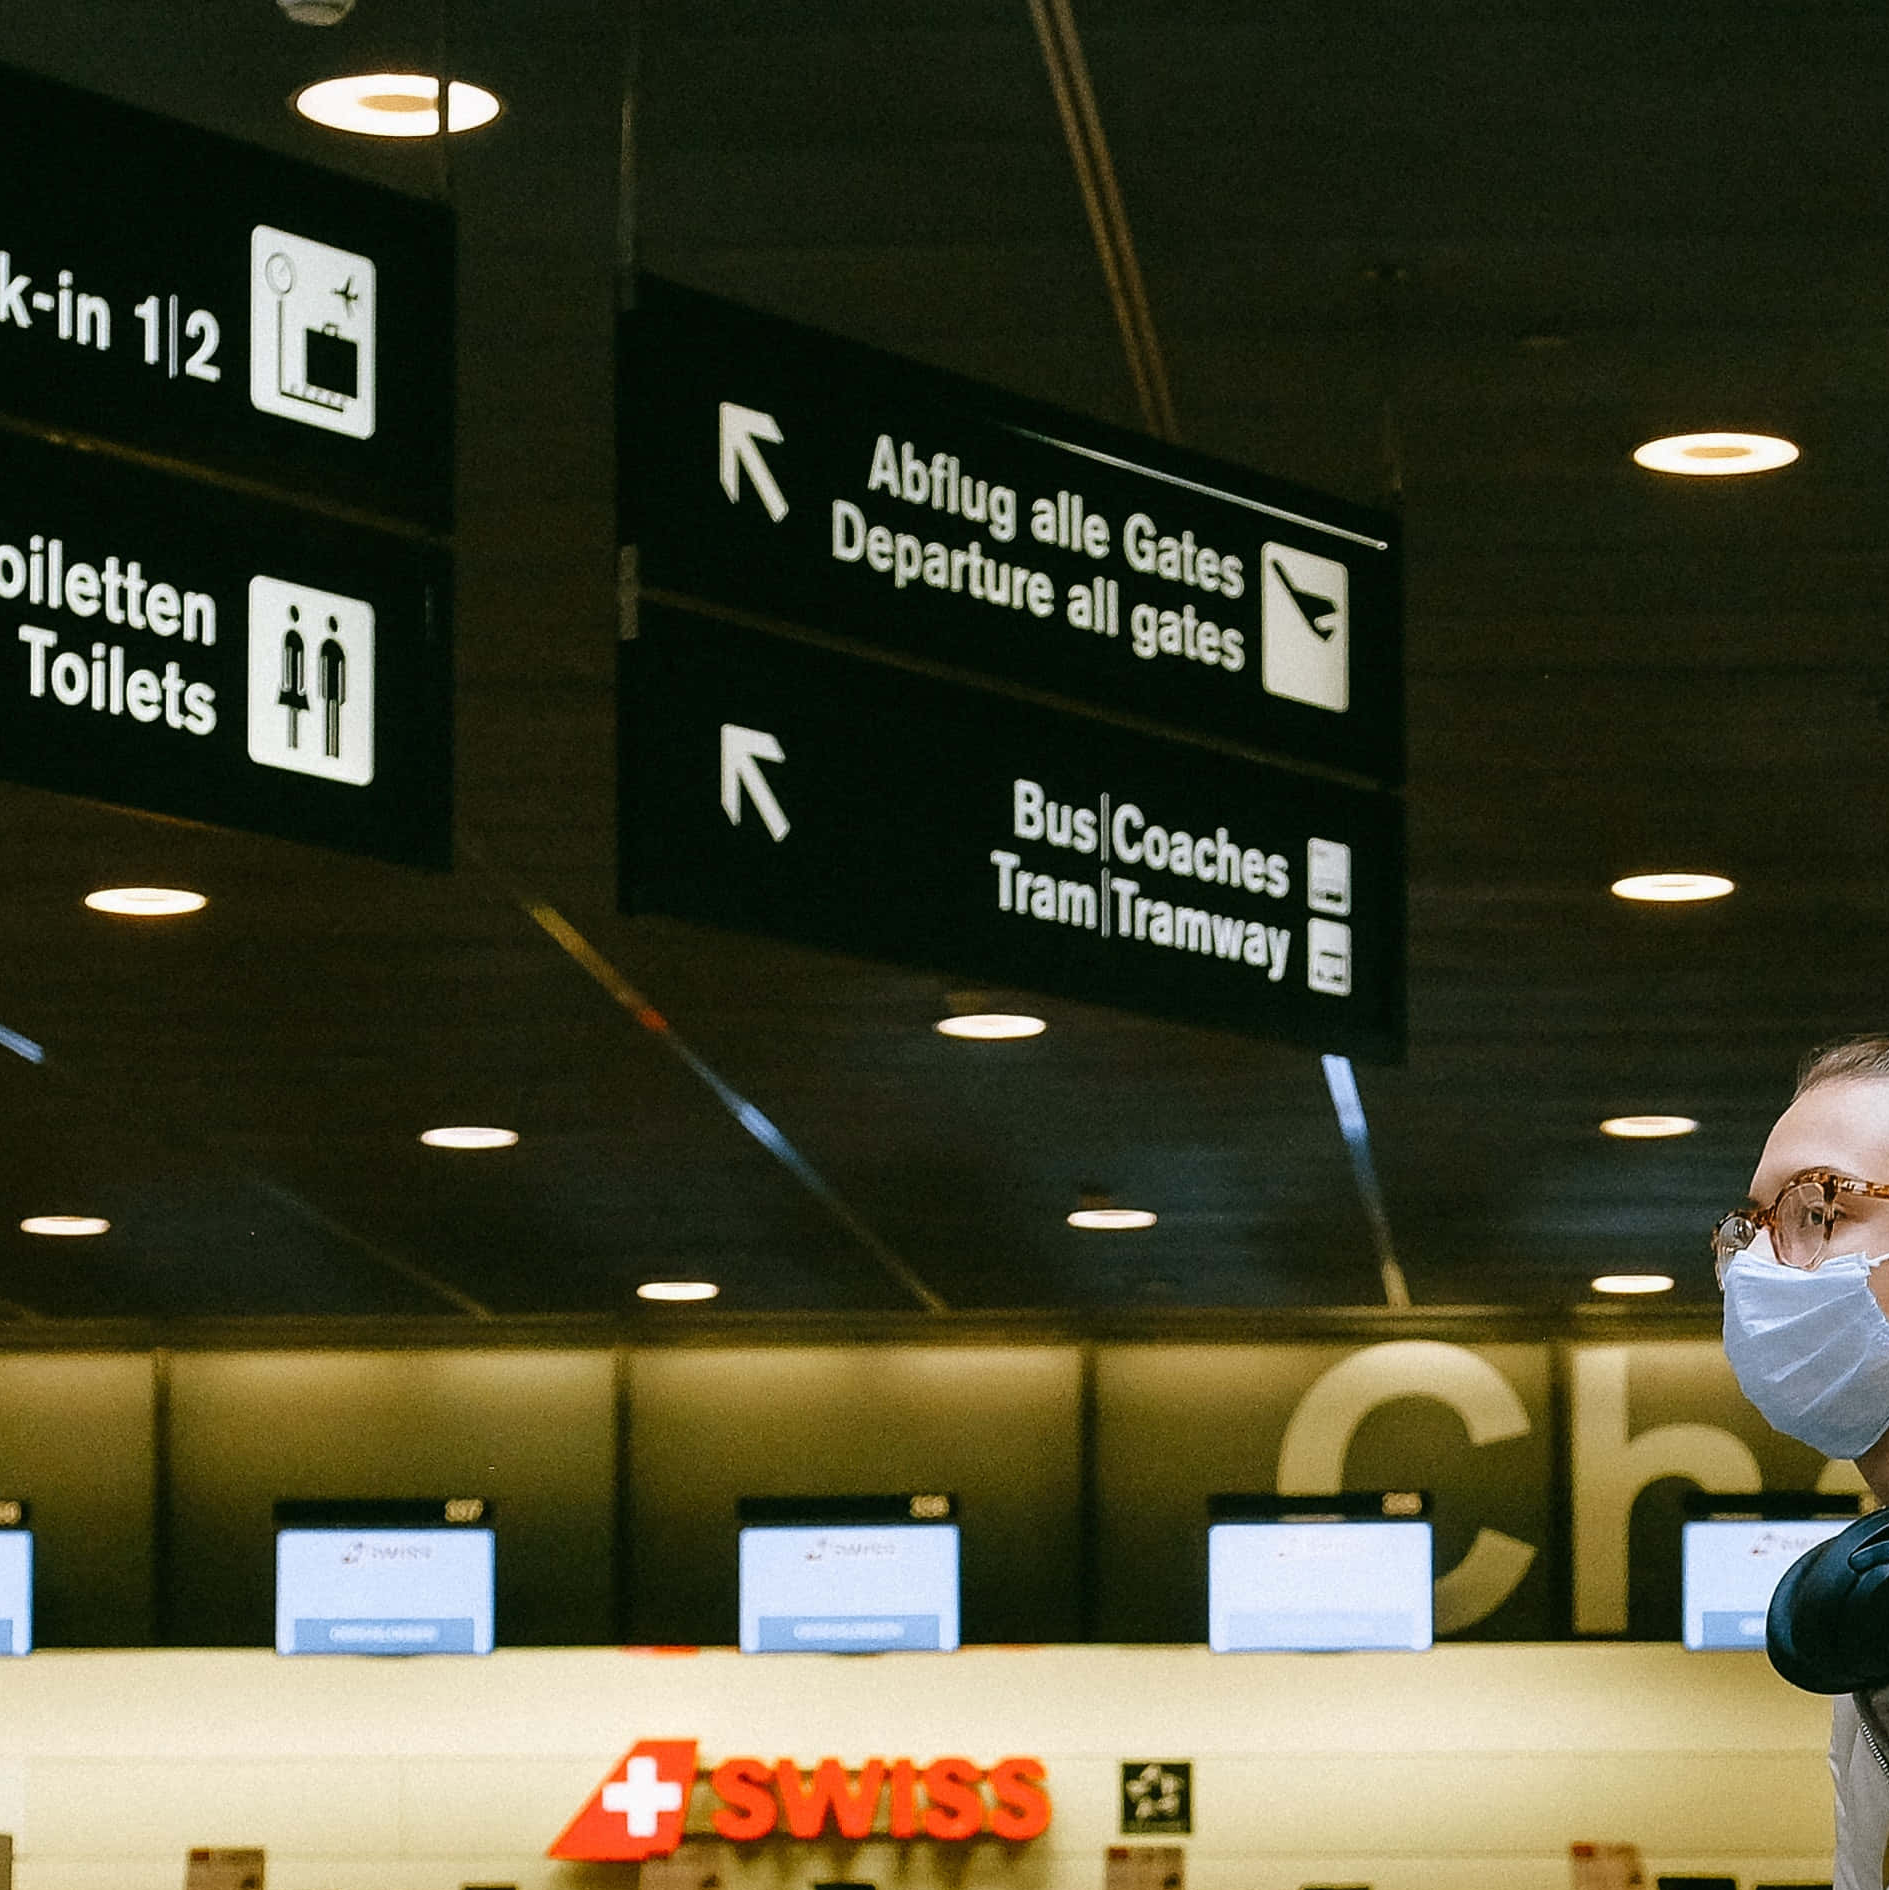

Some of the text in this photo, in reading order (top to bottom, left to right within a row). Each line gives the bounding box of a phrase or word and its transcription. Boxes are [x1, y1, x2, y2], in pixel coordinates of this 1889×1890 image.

[831, 498, 1246, 672] Departure all gates
[867, 434, 1245, 599] Abflug alle Gates
[18, 624, 217, 736] Toilets
[709, 1755, 1054, 1843] SWISS
